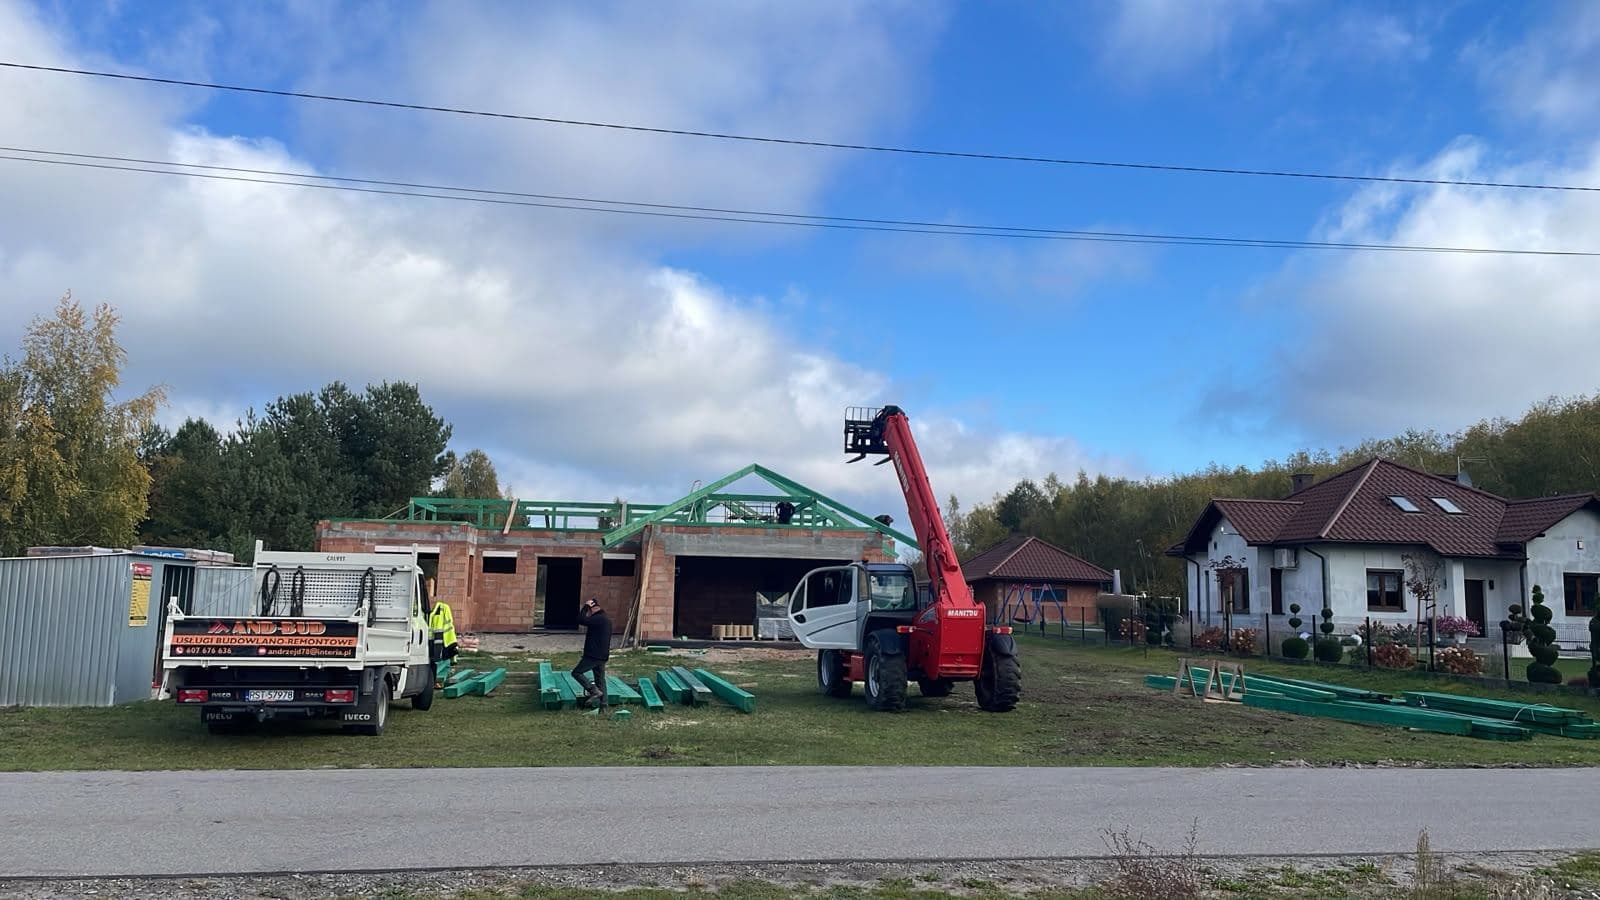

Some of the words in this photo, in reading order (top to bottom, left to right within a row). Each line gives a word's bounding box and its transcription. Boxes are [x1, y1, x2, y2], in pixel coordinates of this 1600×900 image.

[947, 609, 979, 617] MANITOU
[232, 620, 327, 635] AND-BUD
[175, 636, 214, 645] USŁUGI
[344, 713, 371, 721] IVECO
